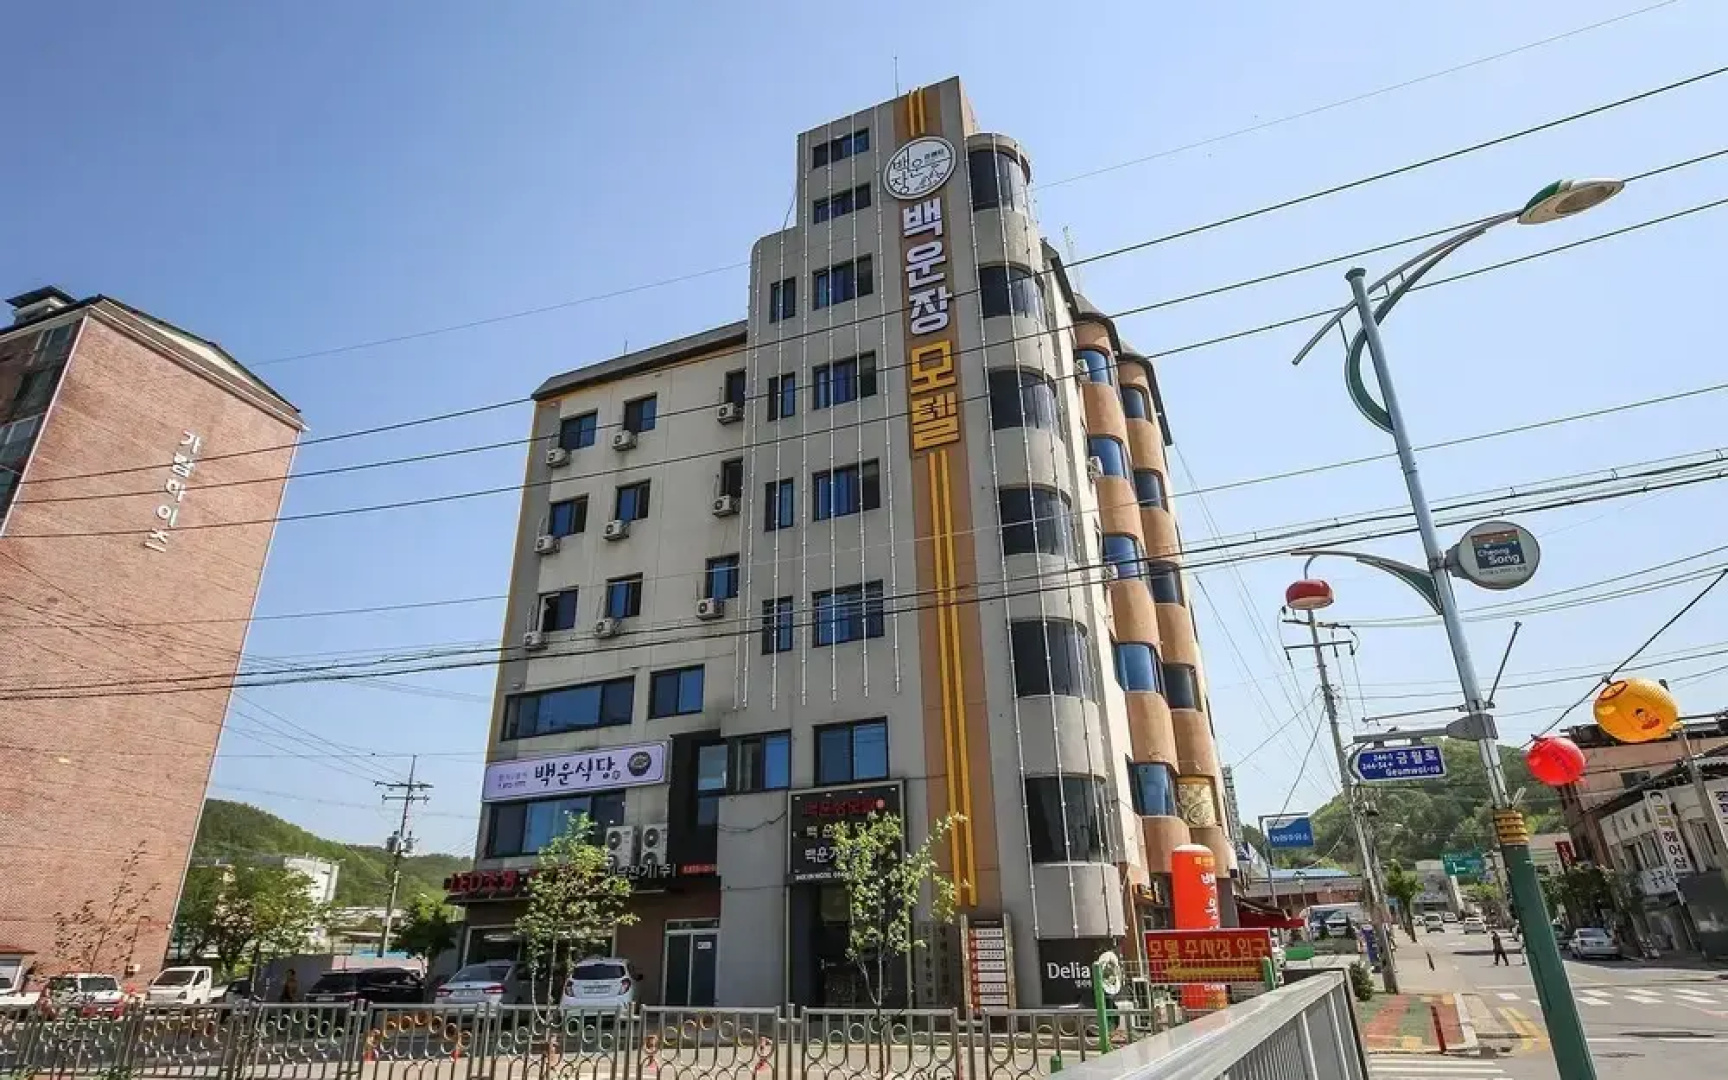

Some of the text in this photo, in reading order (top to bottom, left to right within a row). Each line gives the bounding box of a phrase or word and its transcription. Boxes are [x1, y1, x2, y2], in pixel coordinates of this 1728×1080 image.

[902, 196, 960, 451] 백운장 모텔
[534, 757, 616, 787] 백운식당
[1148, 936, 1268, 960] 모텔 주차장 입구
[1047, 961, 1091, 979] Delia
